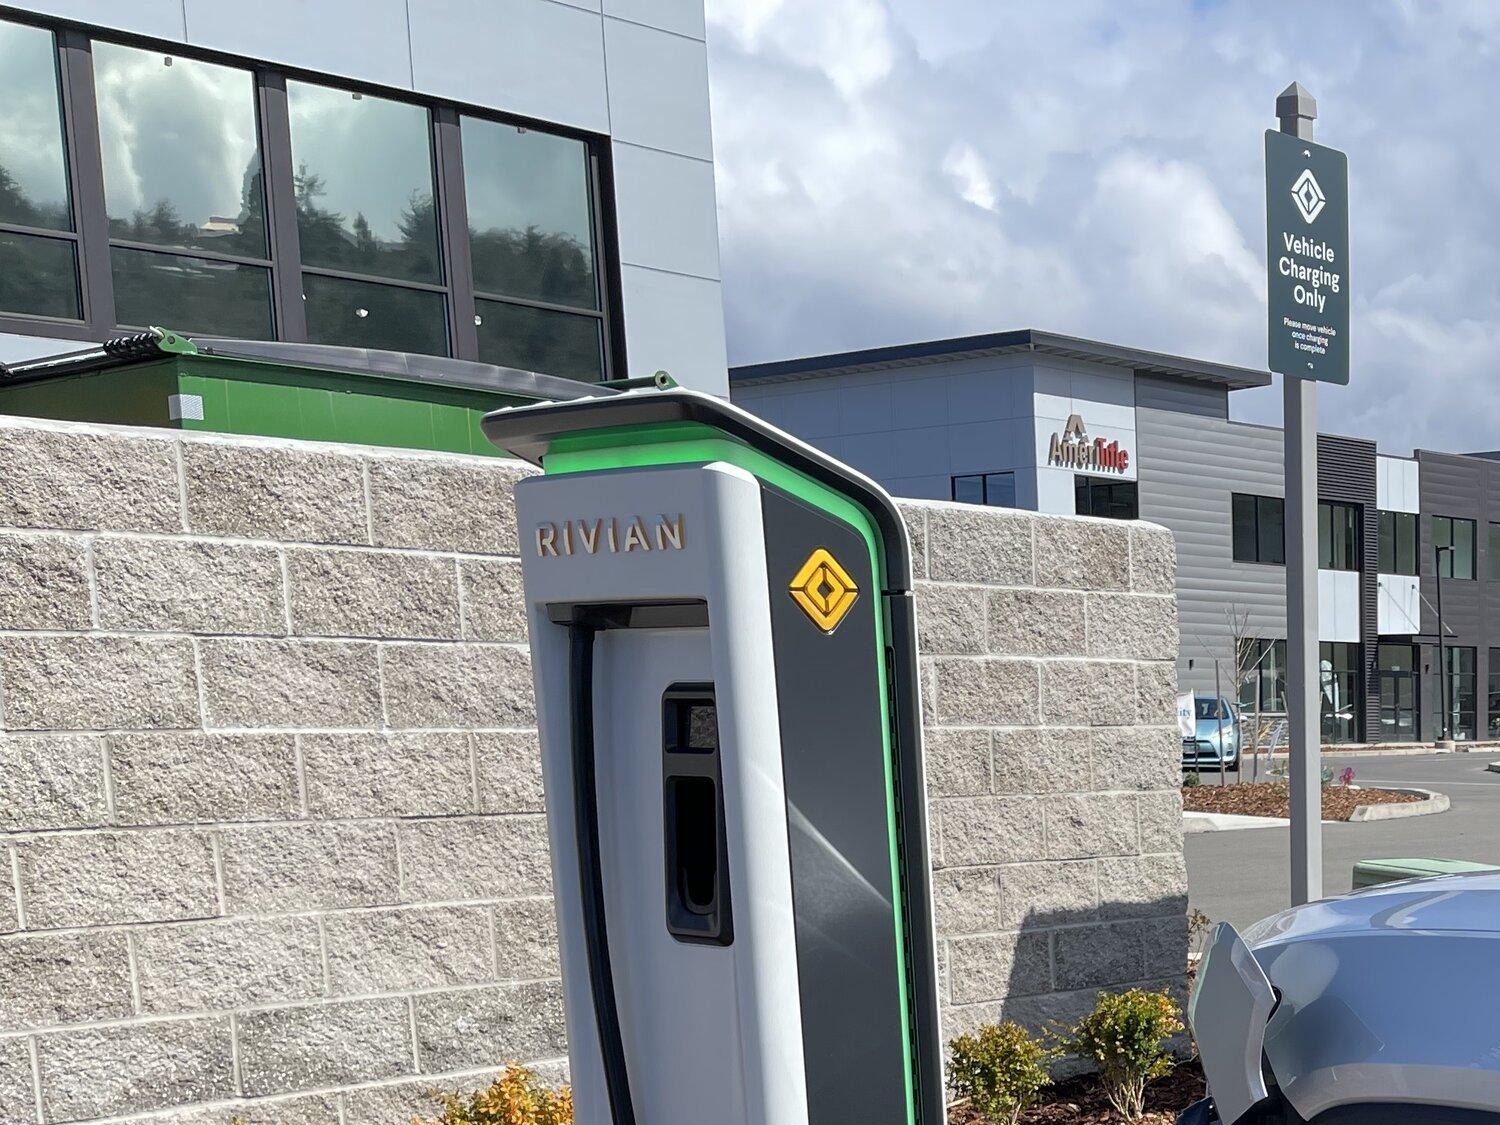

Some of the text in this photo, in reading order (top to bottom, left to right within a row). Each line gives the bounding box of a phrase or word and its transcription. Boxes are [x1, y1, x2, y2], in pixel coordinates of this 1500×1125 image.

[1283, 231, 1335, 263] Vehicle
[1279, 256, 1340, 293] Charging
[1293, 285, 1326, 313] Only
[1283, 316, 1336, 336] Please move vehicle
[1291, 331, 1328, 347] once charging
[1294, 340, 1325, 354] is complete
[1048, 432, 1129, 474] AmeriTitle
[535, 513, 685, 557] RIVIAN
